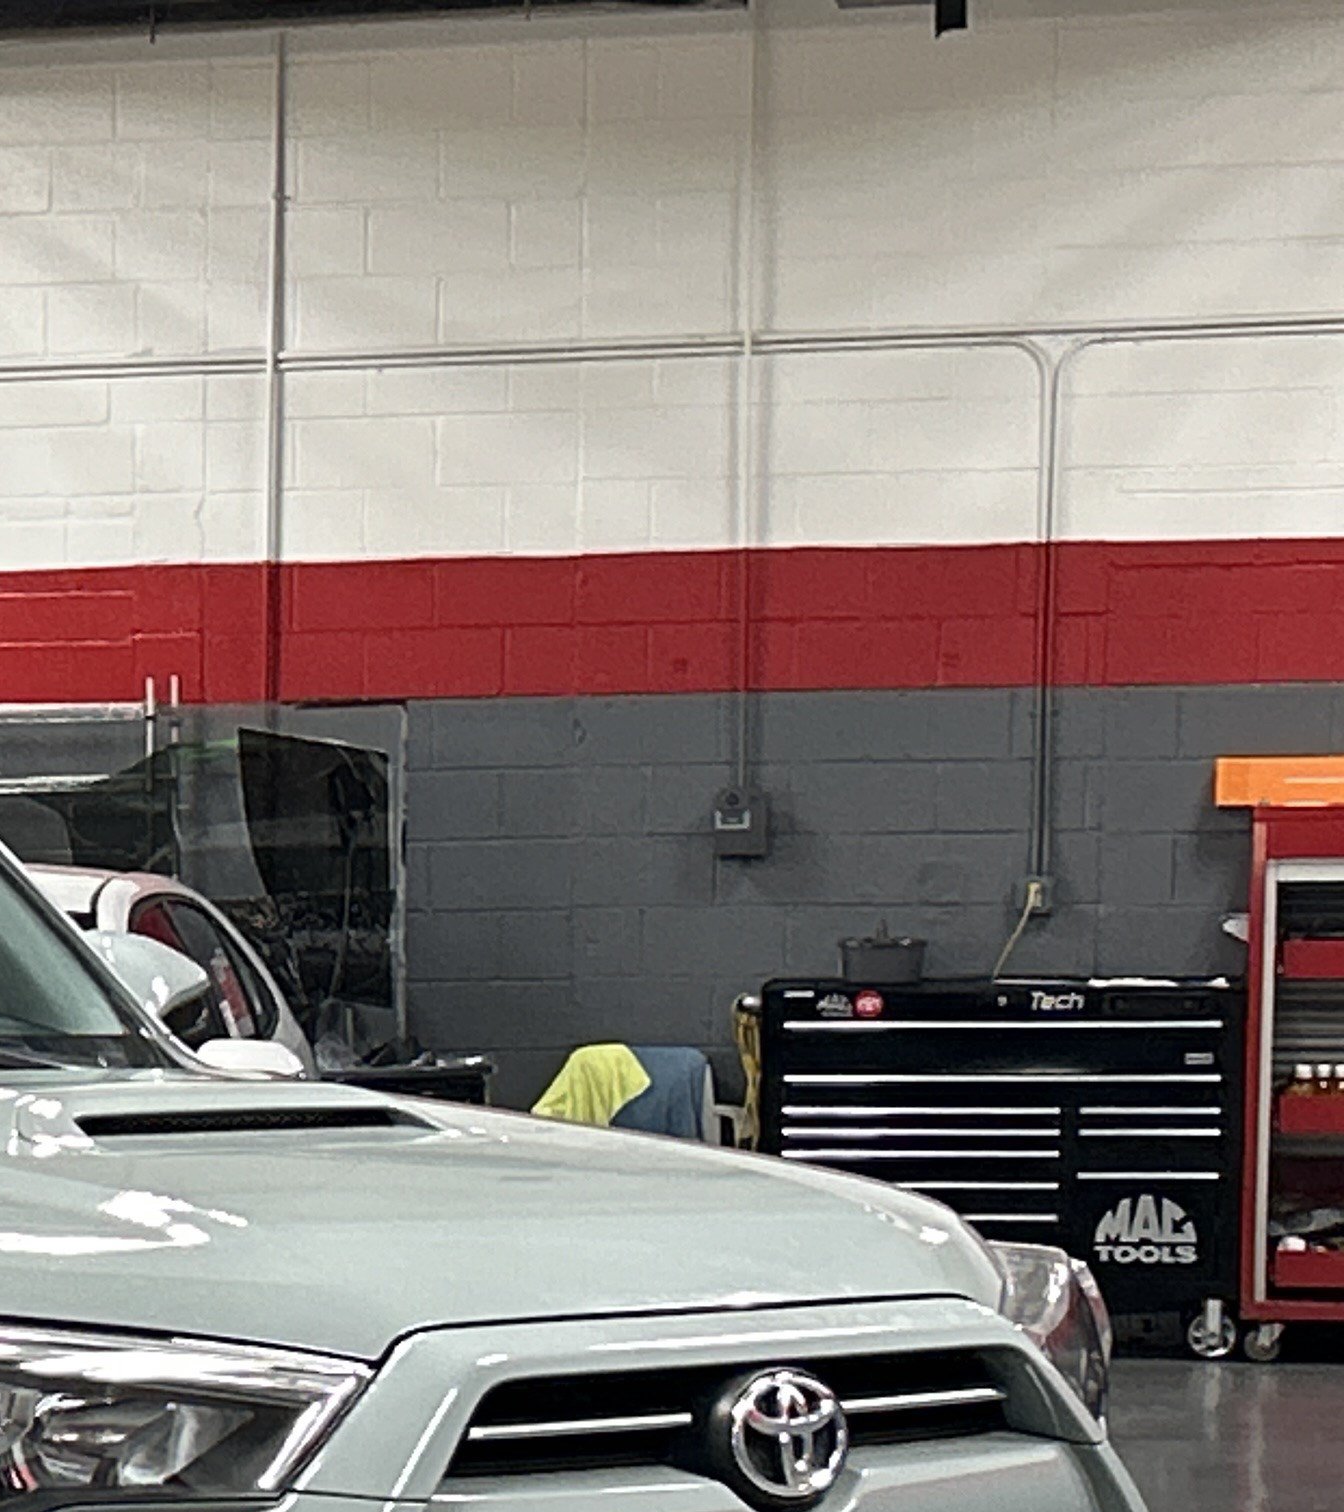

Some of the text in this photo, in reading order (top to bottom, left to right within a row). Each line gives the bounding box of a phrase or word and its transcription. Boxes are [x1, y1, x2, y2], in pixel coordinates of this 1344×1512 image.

[1031, 990, 1085, 1011] Tech
[1094, 1193, 1197, 1243] MAC
[1093, 1245, 1198, 1264] TOOLS
